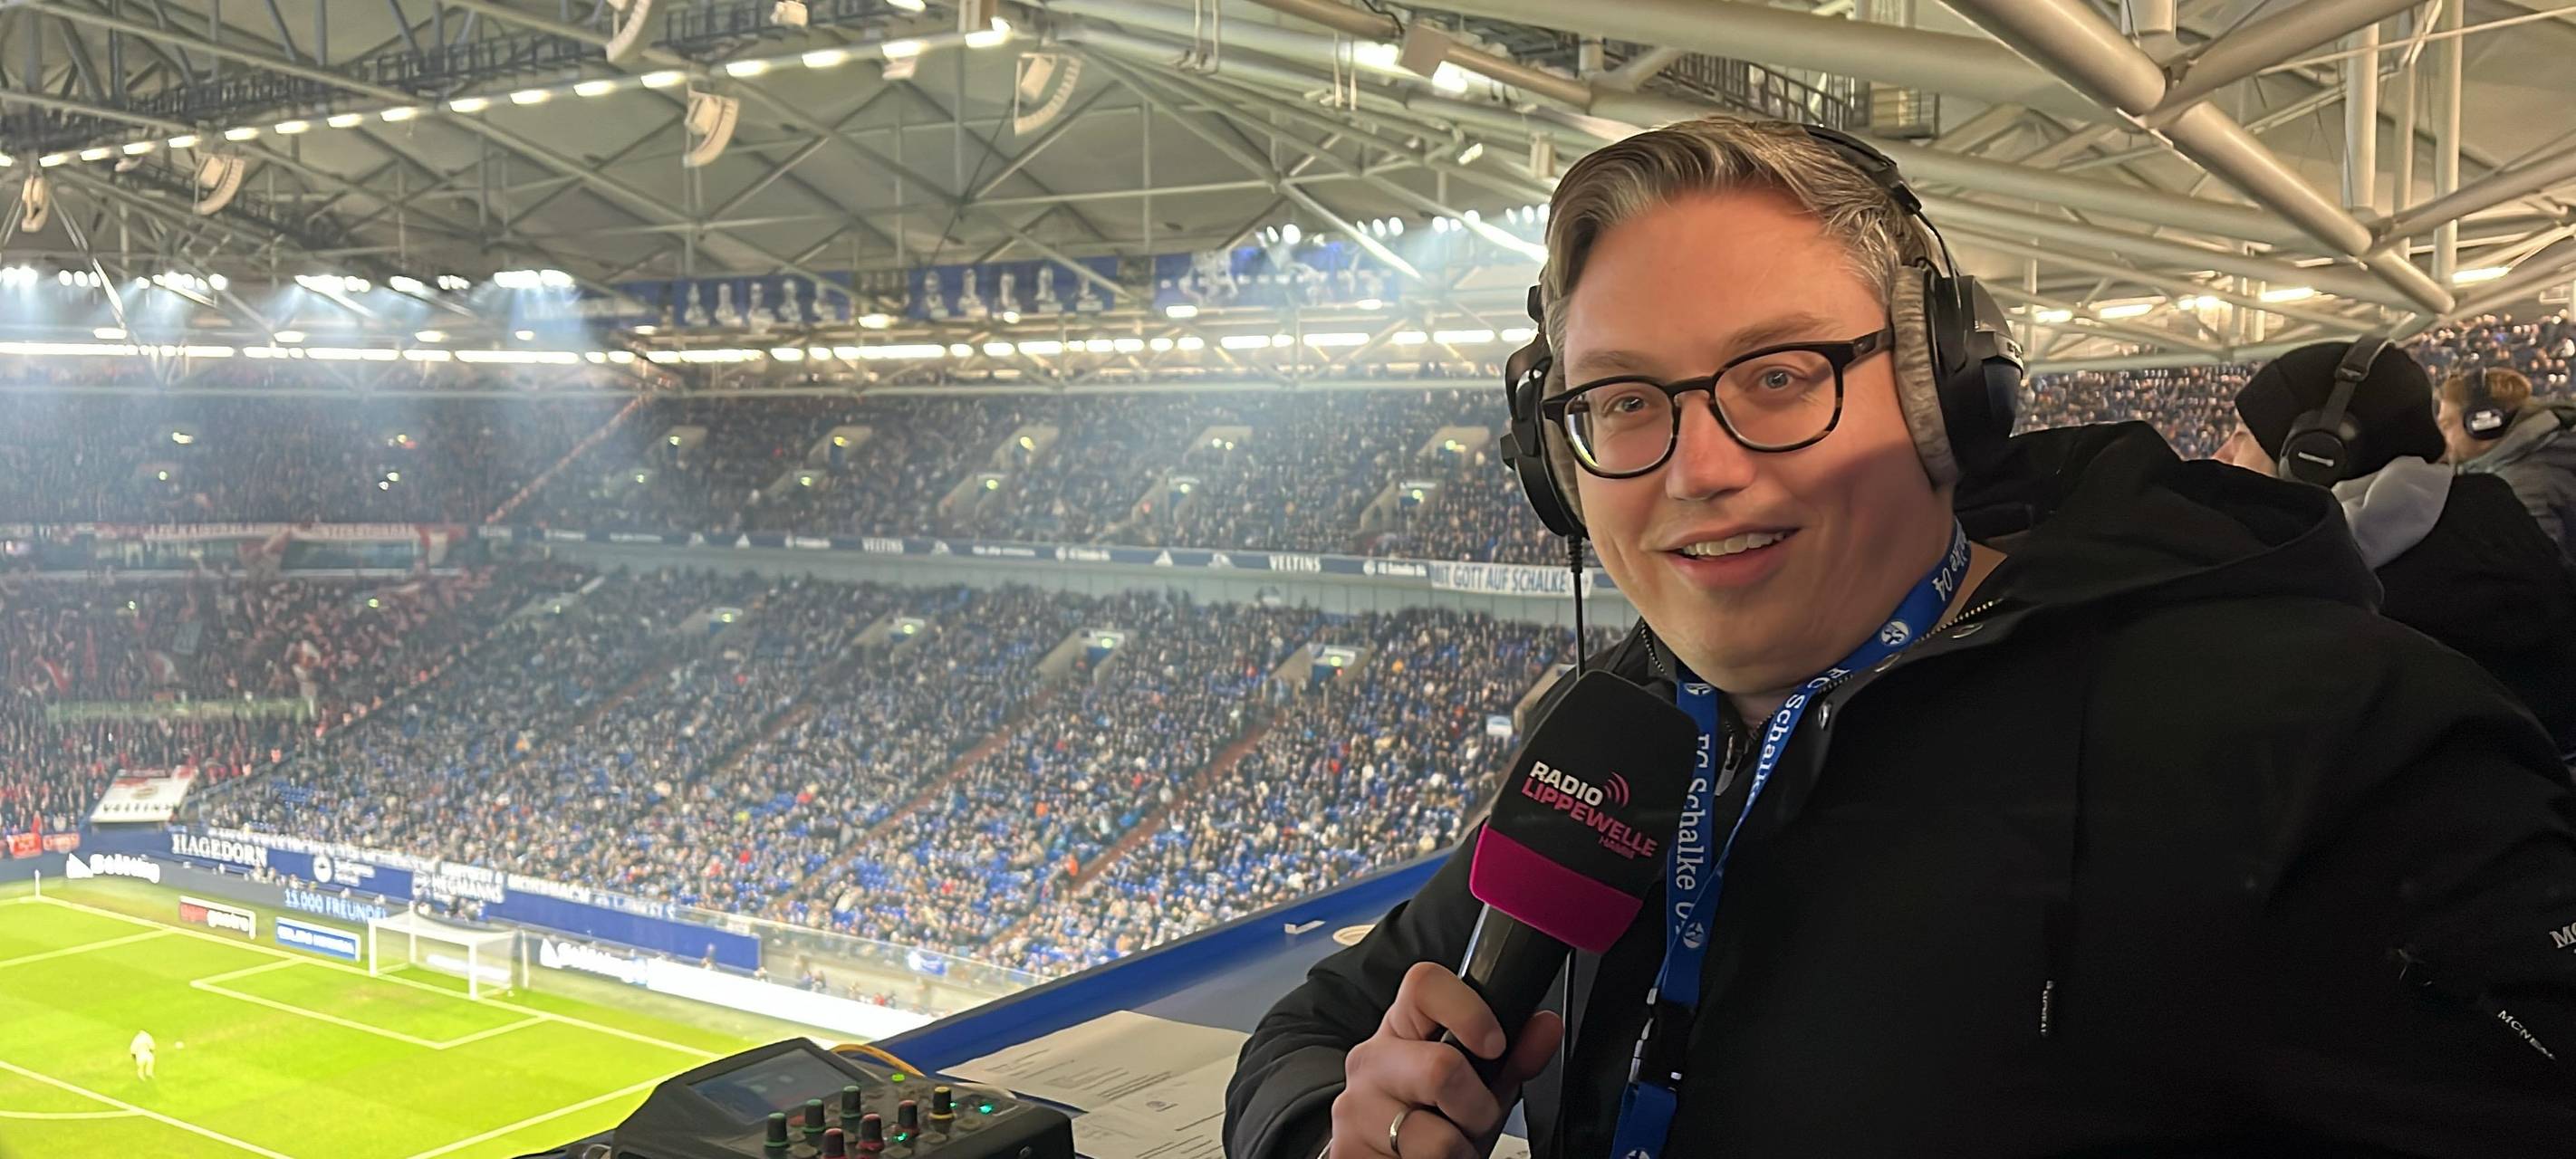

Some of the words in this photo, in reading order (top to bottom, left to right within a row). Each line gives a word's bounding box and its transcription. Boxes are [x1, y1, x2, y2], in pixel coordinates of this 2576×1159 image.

[1269, 554, 1322, 573] VELTINS
[1453, 566, 1483, 588] GOTT
[1486, 568, 1508, 590] AUF
[1511, 569, 1566, 593] SCHALKE
[1807, 667, 1850, 689] FC
[1529, 761, 1603, 807] RADIO
[1521, 777, 1658, 857] LIPPEWELLE
[1675, 778, 1707, 891] Schalke
[171, 832, 268, 868] HAGEDORN
